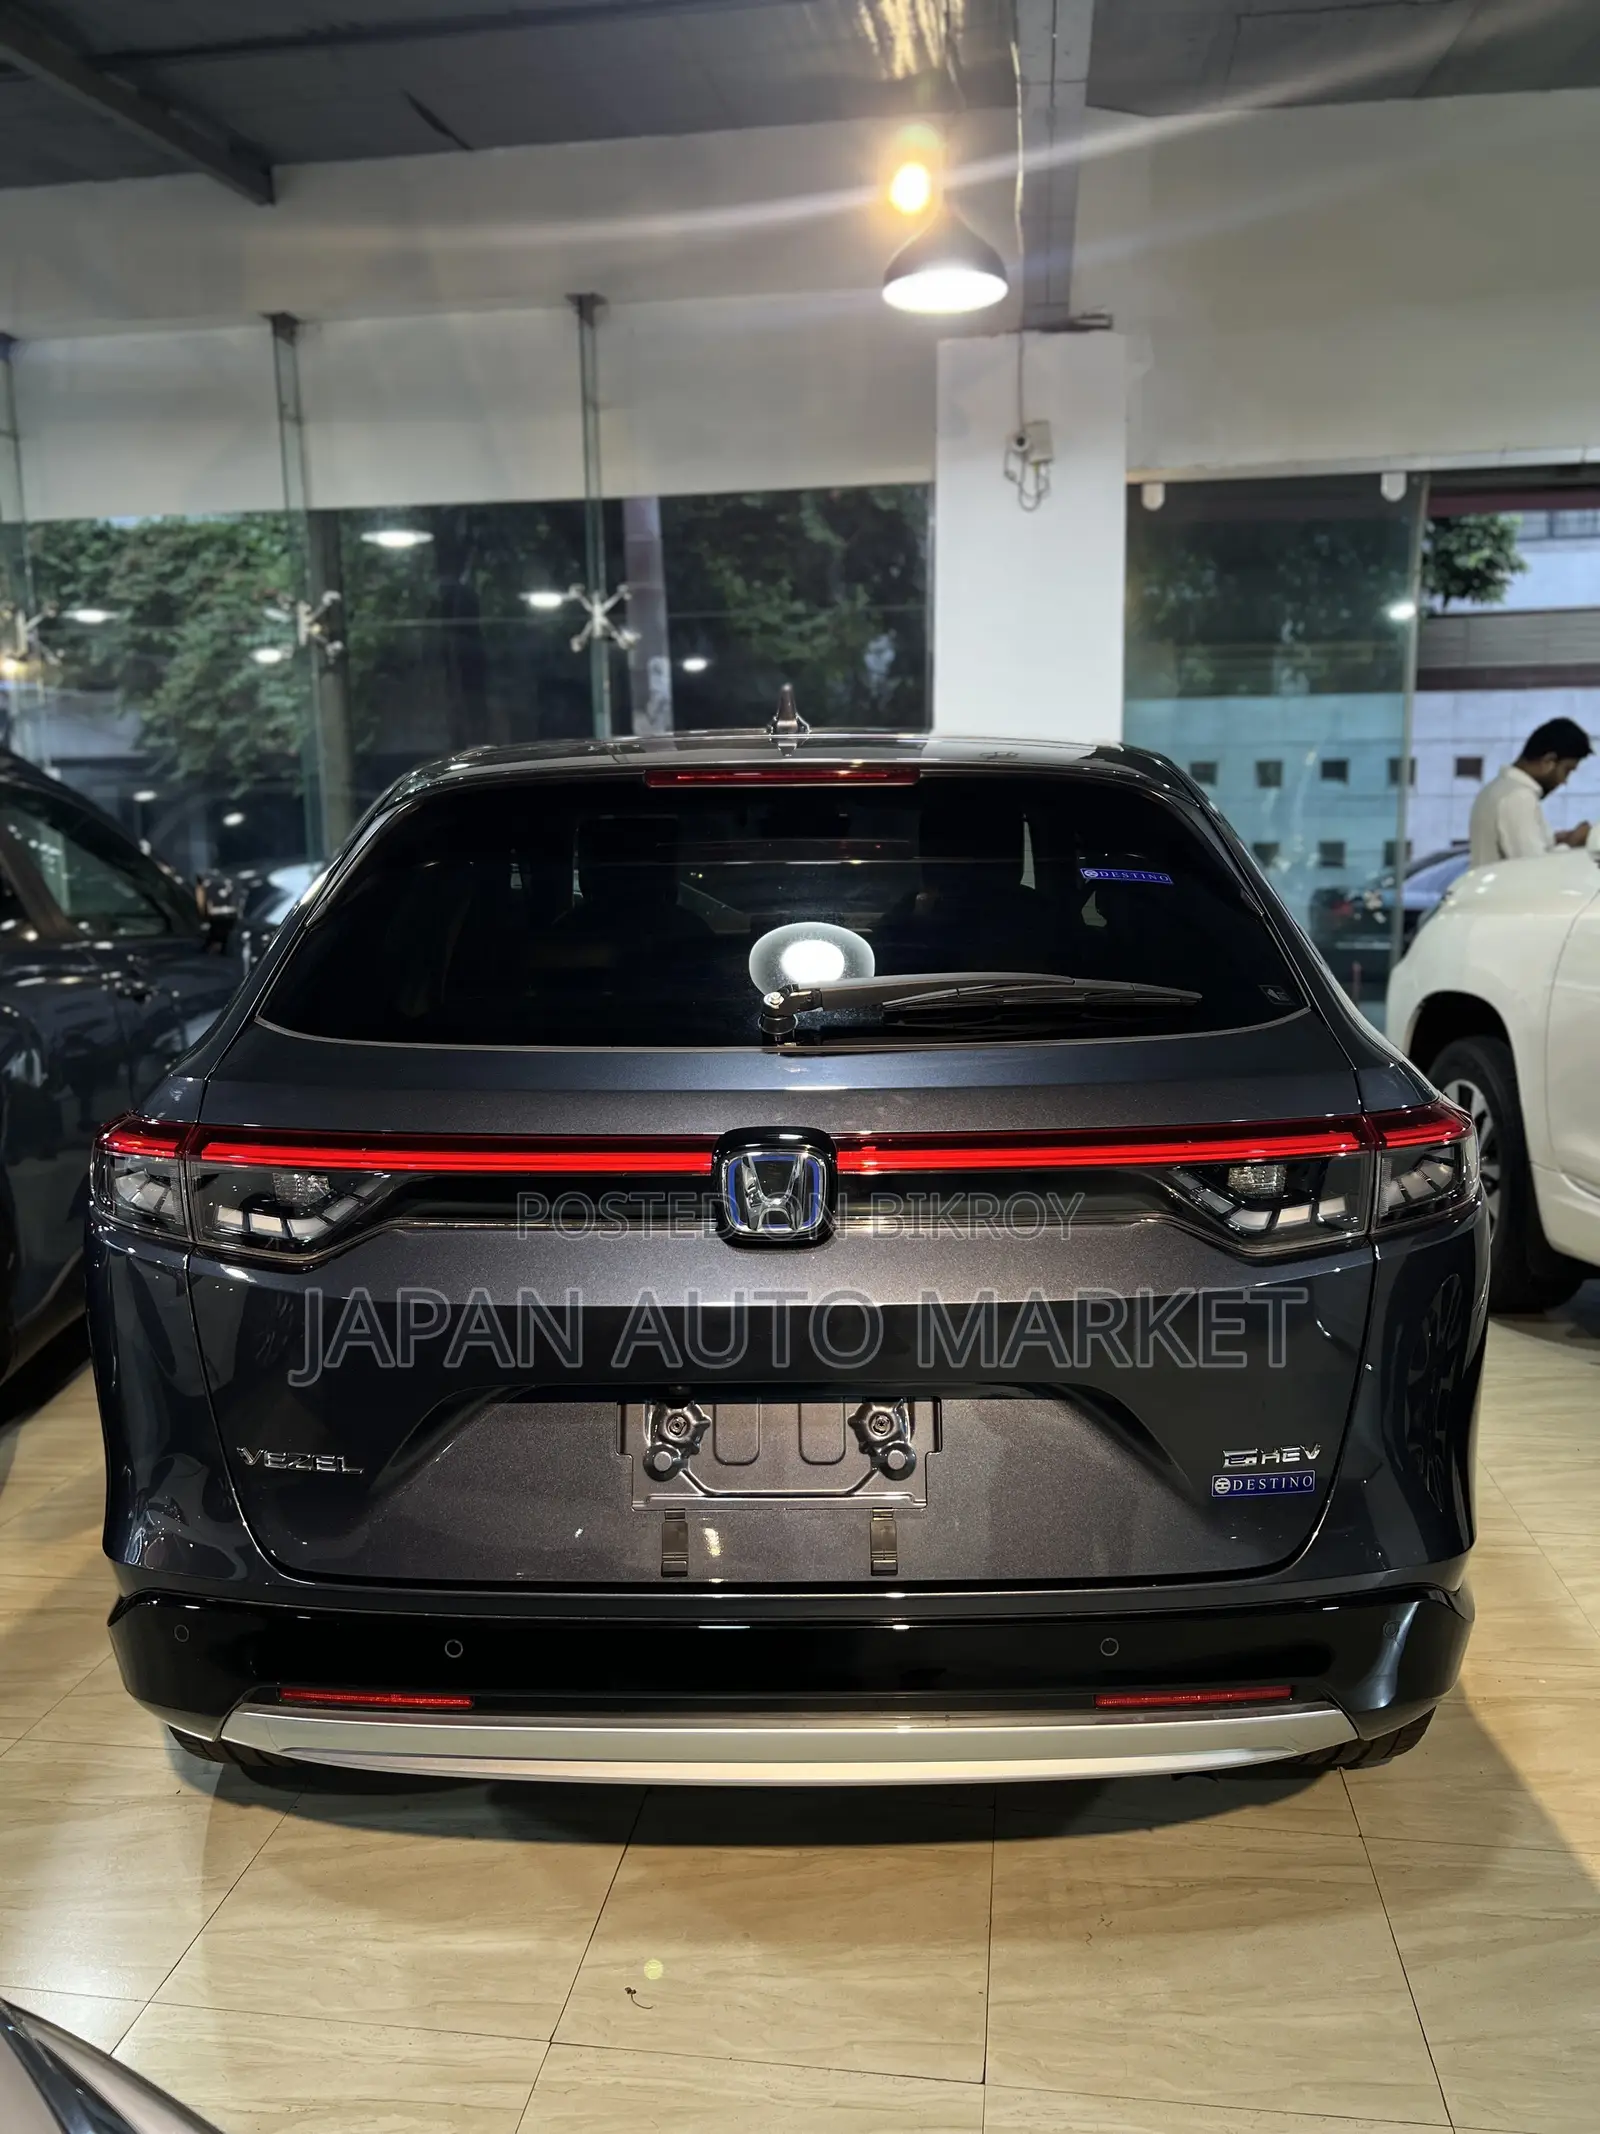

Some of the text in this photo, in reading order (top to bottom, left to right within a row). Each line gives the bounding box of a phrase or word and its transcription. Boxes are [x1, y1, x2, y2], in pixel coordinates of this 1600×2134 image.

[1099, 871, 1169, 881] DESTINO
[236, 1447, 364, 1475] VEZEL
[1233, 1475, 1313, 1491] DESTINO
